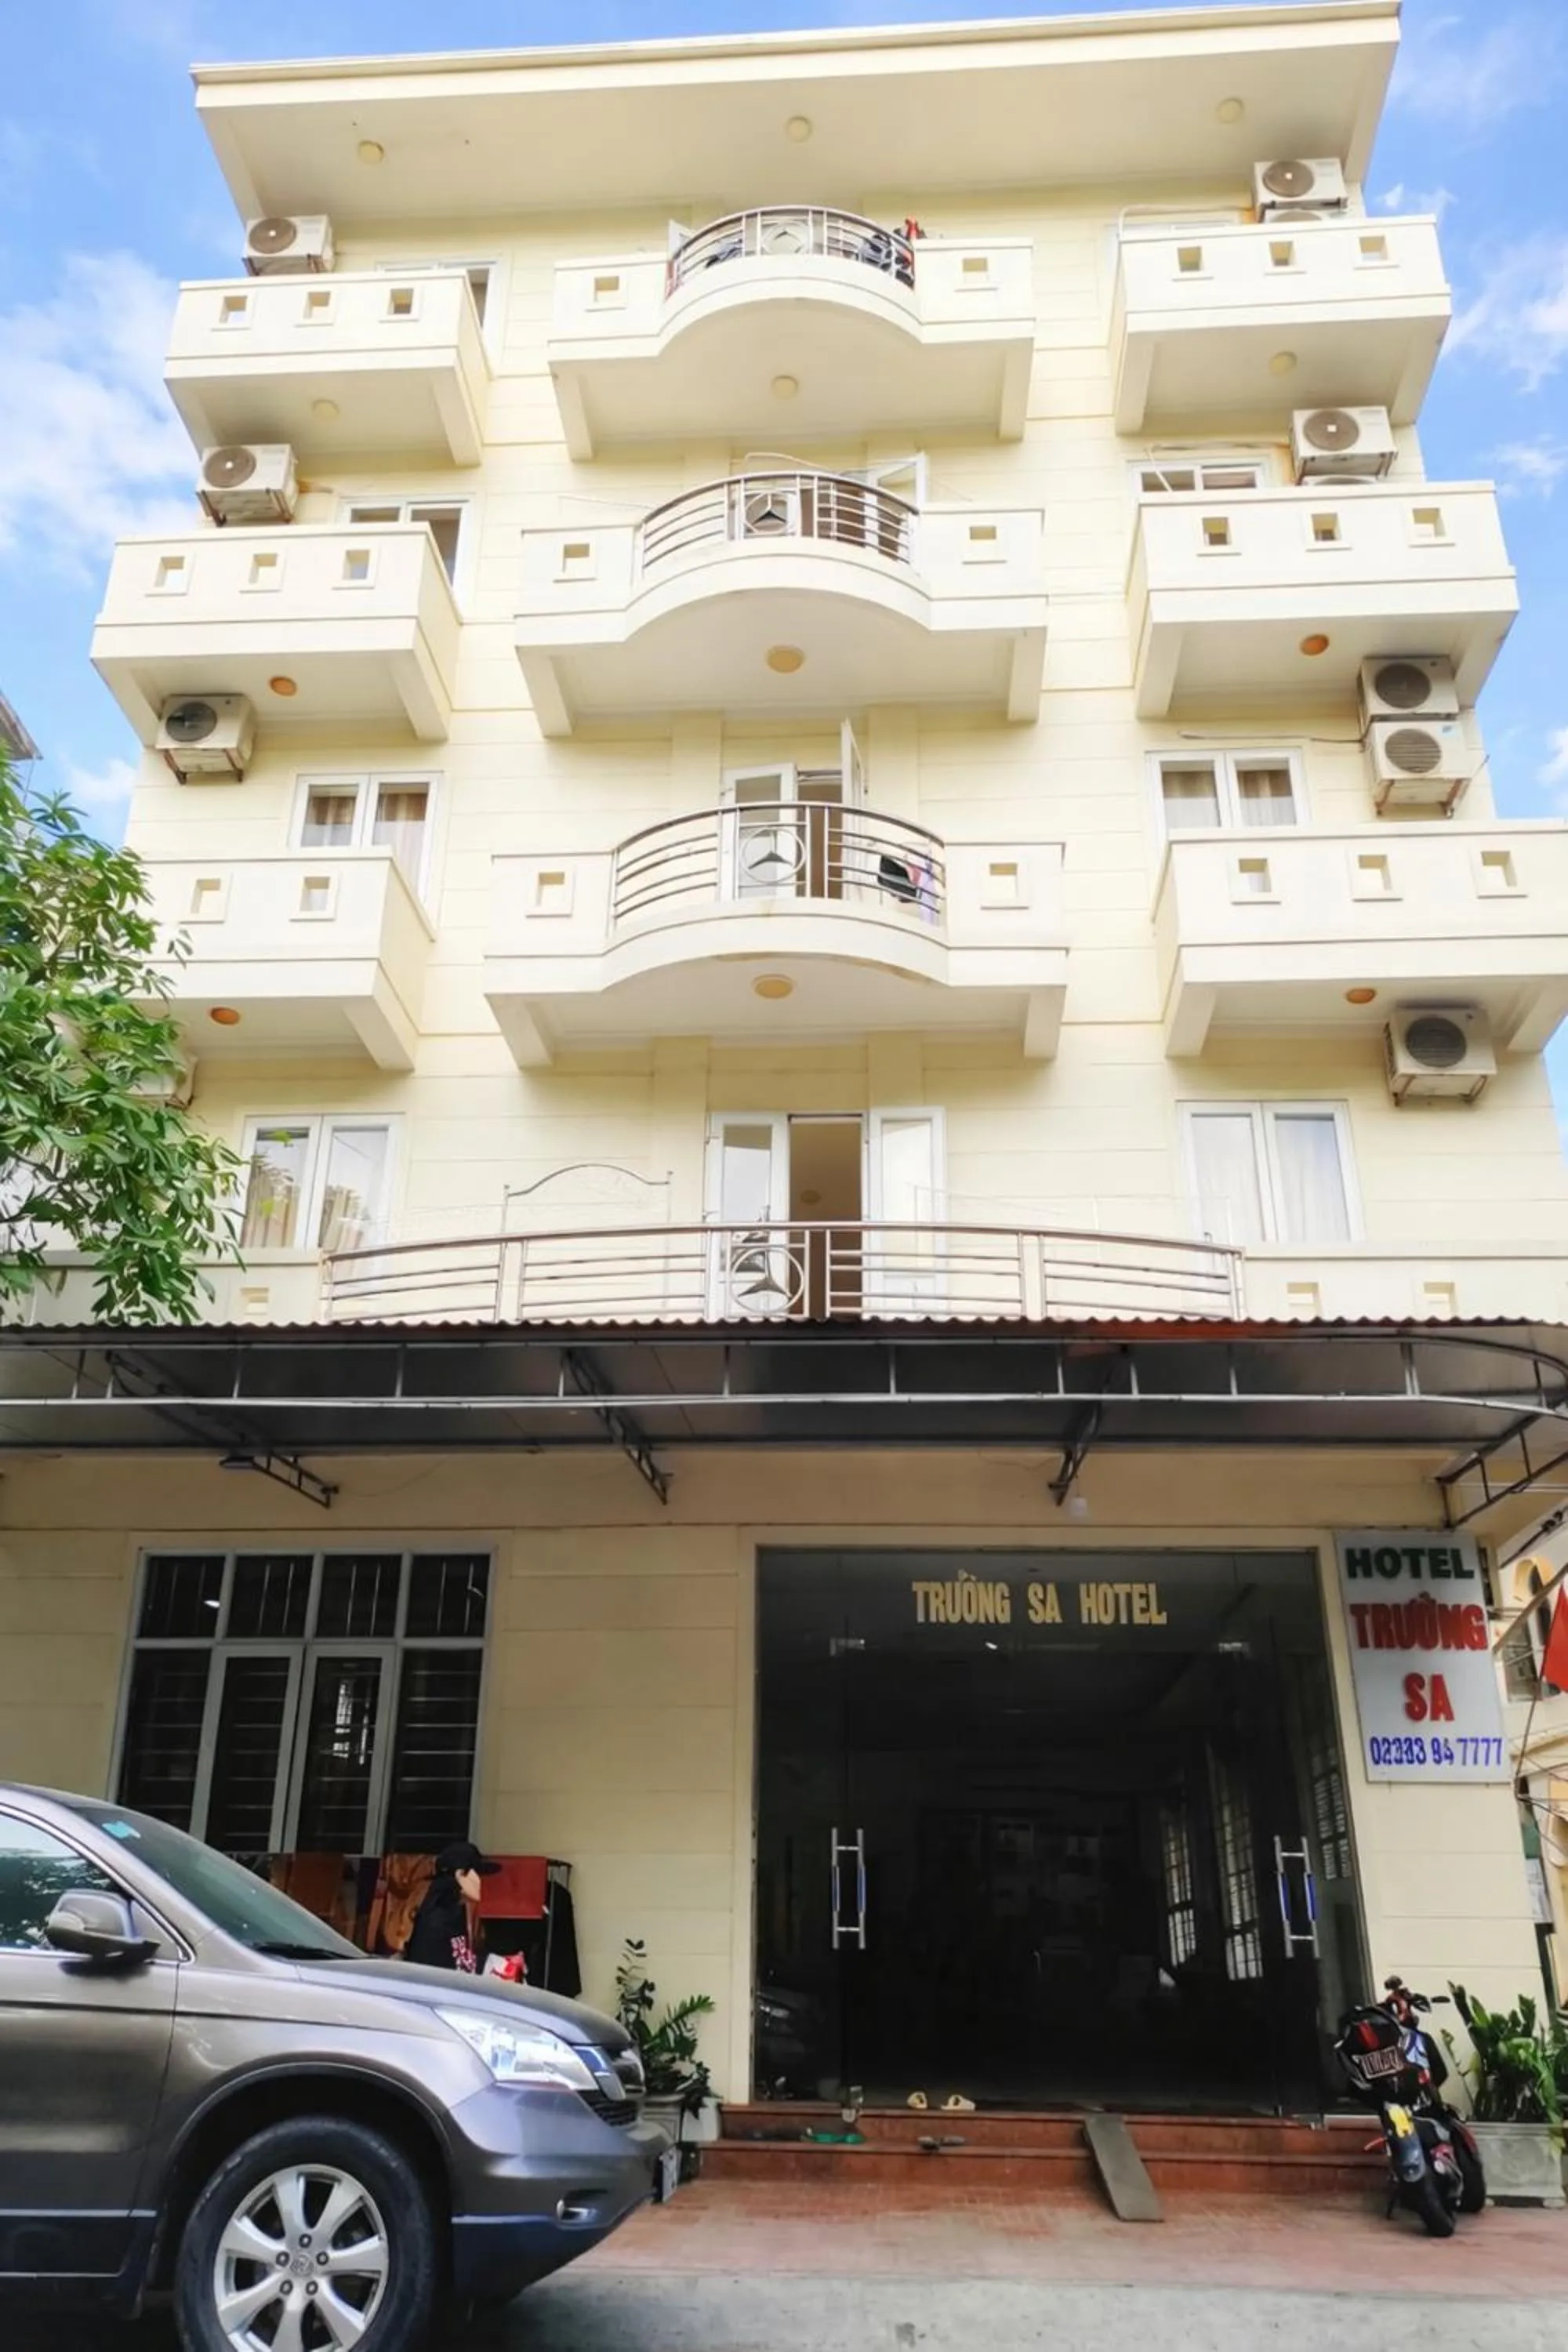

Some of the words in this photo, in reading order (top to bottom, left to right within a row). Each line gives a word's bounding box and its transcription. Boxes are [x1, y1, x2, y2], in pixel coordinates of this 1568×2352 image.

[1345, 1547, 1475, 1580] HOTEL
[1028, 1582, 1062, 1624] SA
[1080, 1582, 1167, 1624] HOTEL
[1403, 1671, 1454, 1722] SA
